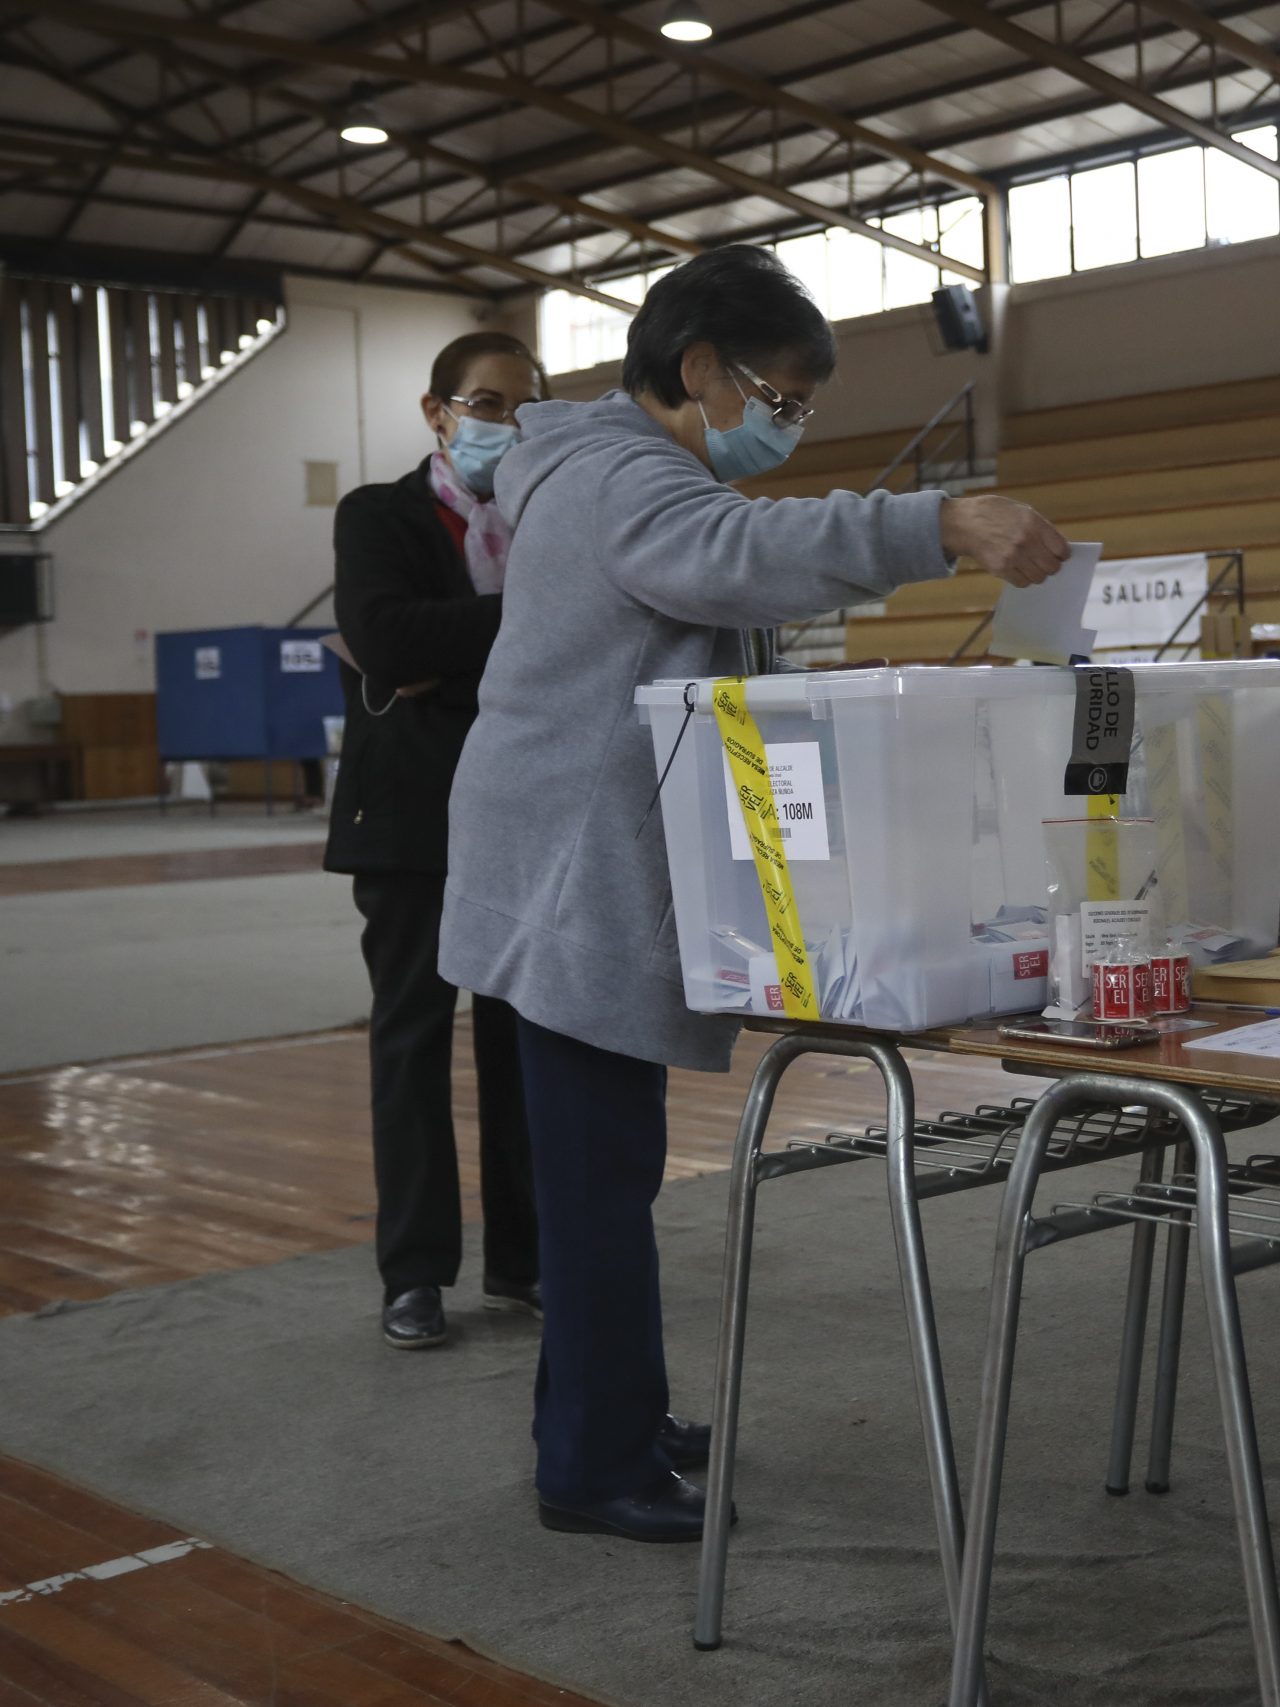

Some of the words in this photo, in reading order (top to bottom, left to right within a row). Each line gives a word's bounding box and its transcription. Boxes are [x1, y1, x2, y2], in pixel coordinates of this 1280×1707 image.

[1103, 580, 1183, 605] SALIDA
[1086, 670, 1103, 750] URIDAD
[1103, 711, 1119, 737] DE
[745, 794, 764, 811] VEL
[782, 802, 813, 820] 108M
[1019, 955, 1031, 977] SER
[1105, 973, 1127, 989] SER
[769, 986, 782, 1009] SER
